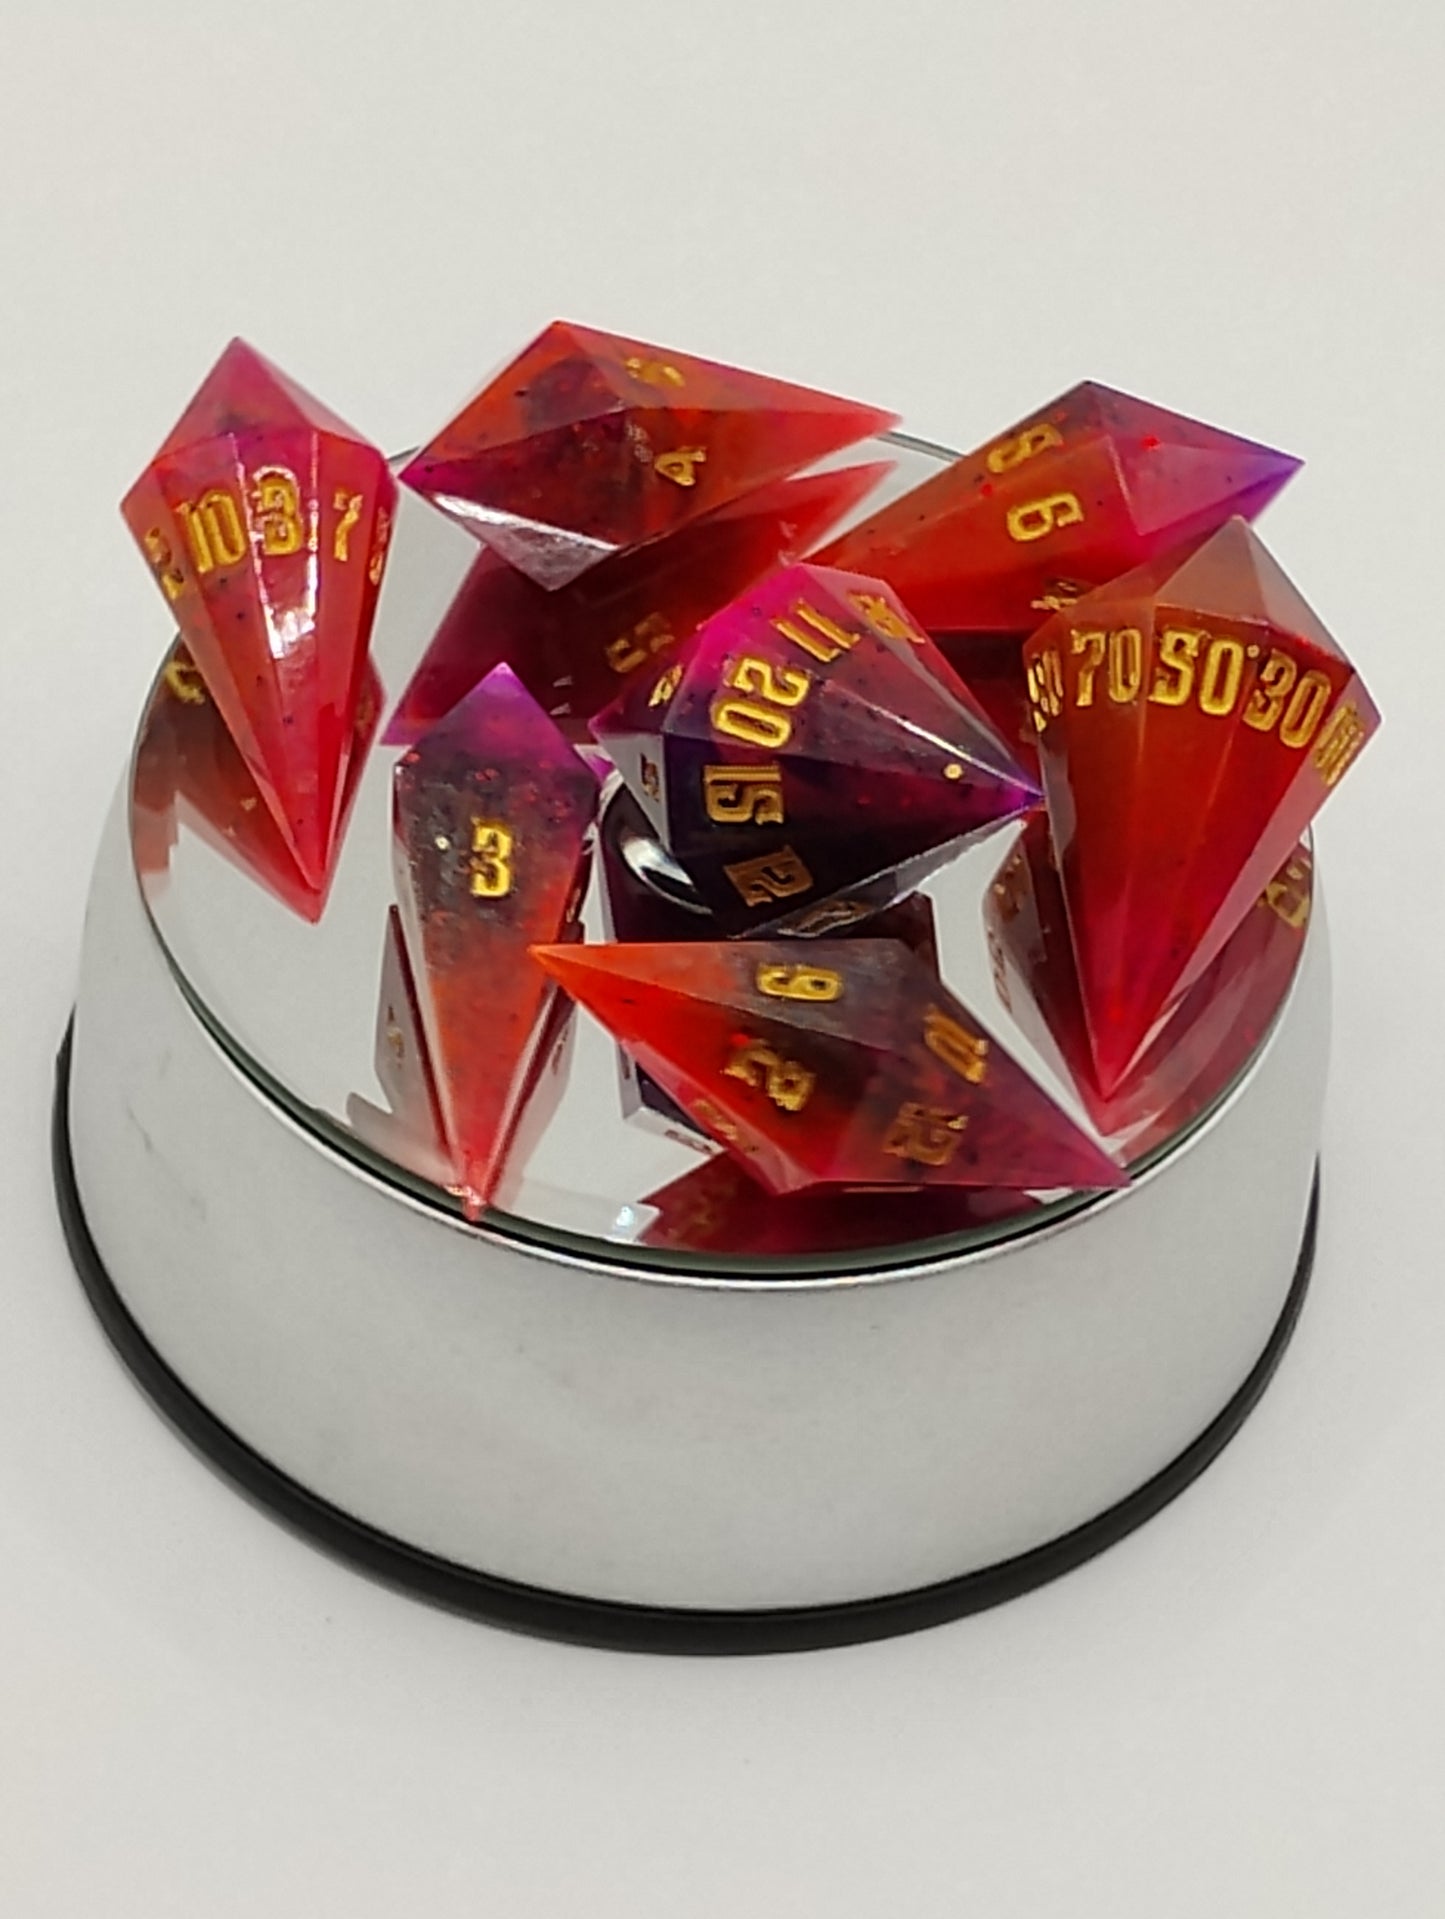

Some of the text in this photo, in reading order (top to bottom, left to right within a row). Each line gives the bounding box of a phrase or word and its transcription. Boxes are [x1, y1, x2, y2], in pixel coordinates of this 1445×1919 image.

[175, 489, 247, 575] 10
[252, 466, 302, 556] 3
[332, 489, 364, 562] 7
[770, 597, 861, 663] 11
[712, 657, 811, 748] 20
[1070, 626, 1141, 706] 70
[1149, 630, 1244, 716] 50
[1243, 647, 1332, 748] 30
[703, 764, 784, 825] 15
[470, 817, 512, 899] 3
[723, 846, 814, 908] 12
